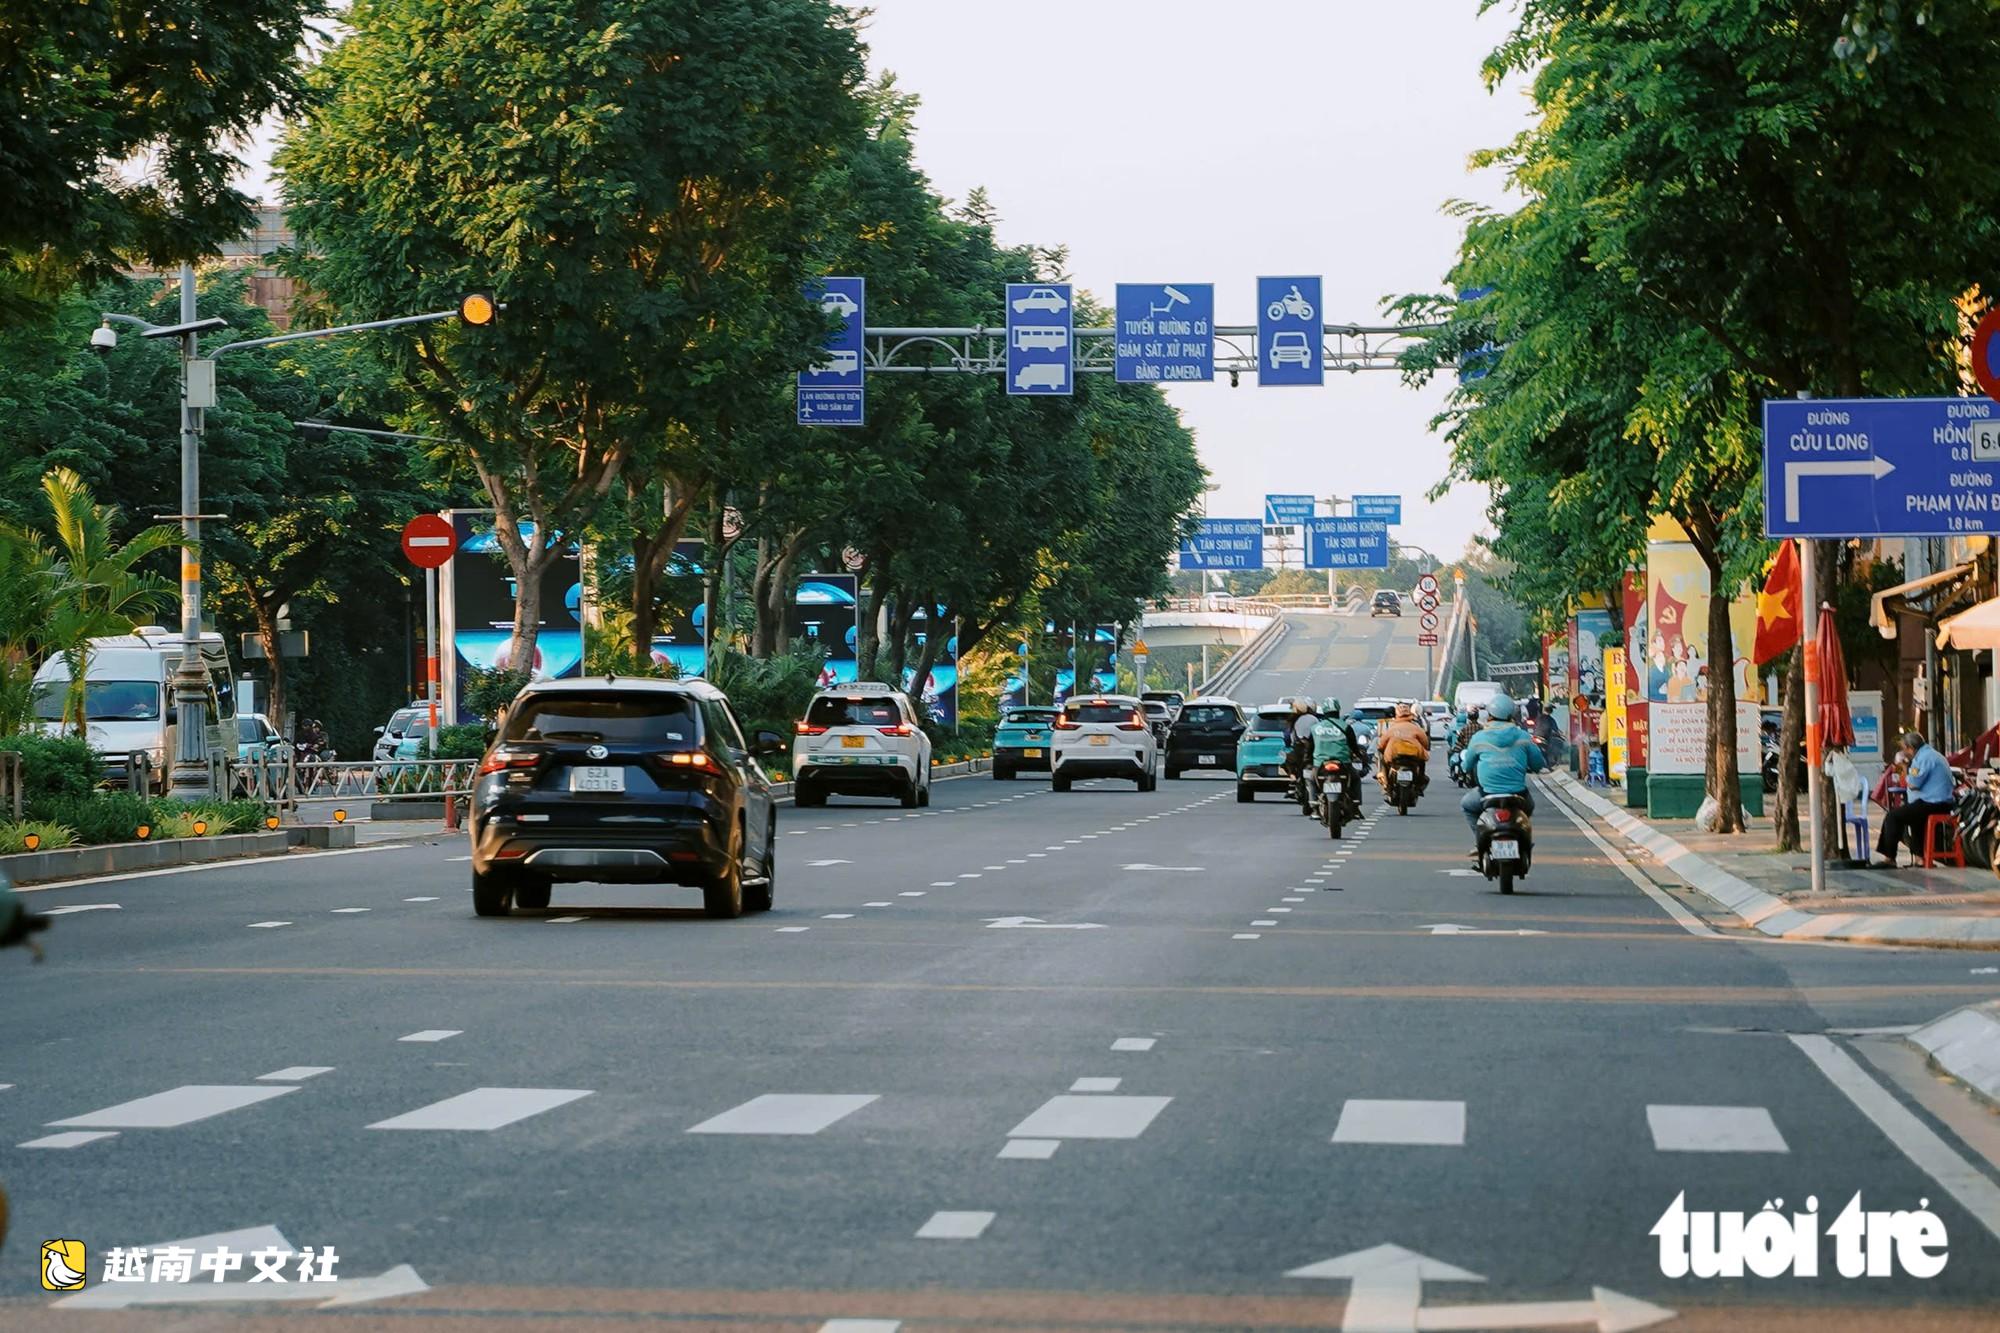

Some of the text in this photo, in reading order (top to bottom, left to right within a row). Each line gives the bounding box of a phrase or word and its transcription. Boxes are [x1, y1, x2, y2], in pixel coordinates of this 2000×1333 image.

[1124, 315, 1208, 335] TUYẾN ĐƯỜNG CÓ
[1118, 339, 1142, 358] GIÁM
[1167, 338, 1181, 358] XỬ
[1183, 343, 1207, 360] PHẠT
[1164, 365, 1202, 379] CAMERA
[1947, 401, 1990, 418] ĐƯỜNG
[1807, 408, 1850, 426] ĐƯỜNG
[1790, 428, 1869, 451] CỬU LONG
[1950, 469, 1993, 487] ĐƯỜNG
[1906, 495, 1951, 515] PHẠM
[1954, 491, 1988, 511] VĂN
[1213, 521, 1233, 534] HÀNG
[1337, 519, 1358, 533] HÀNG
[1965, 517, 1984, 531] km
[1200, 538, 1215, 550] TÂN
[1324, 536, 1339, 549] TÂN
[1207, 552, 1223, 566] NHÀ
[1331, 549, 1346, 564] NHÀ
[1314, 725, 1341, 737] Grab
